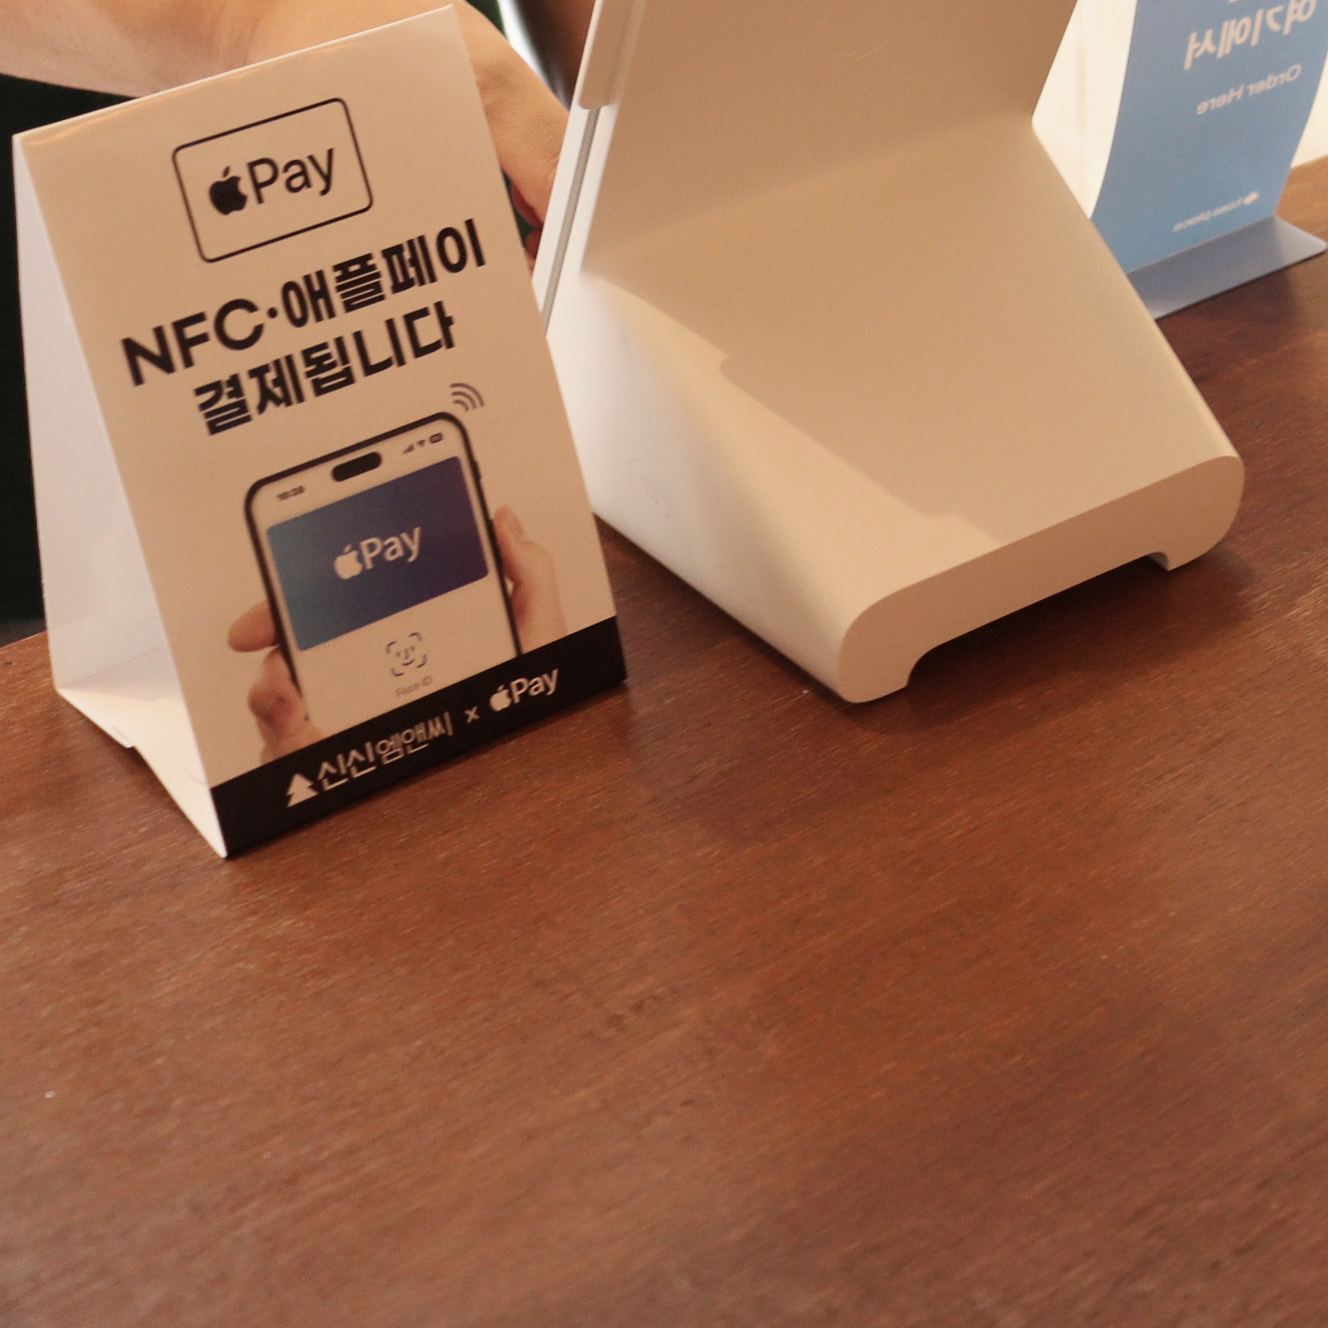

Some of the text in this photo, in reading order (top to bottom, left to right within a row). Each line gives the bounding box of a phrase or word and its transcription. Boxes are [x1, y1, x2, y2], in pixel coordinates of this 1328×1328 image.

[246, 147, 335, 204] Pay
[194, 302, 456, 435] 결제됩니다
[359, 527, 421, 570] Pay
[317, 711, 453, 790] 신신엠앤씨
[509, 668, 560, 705] Pay
